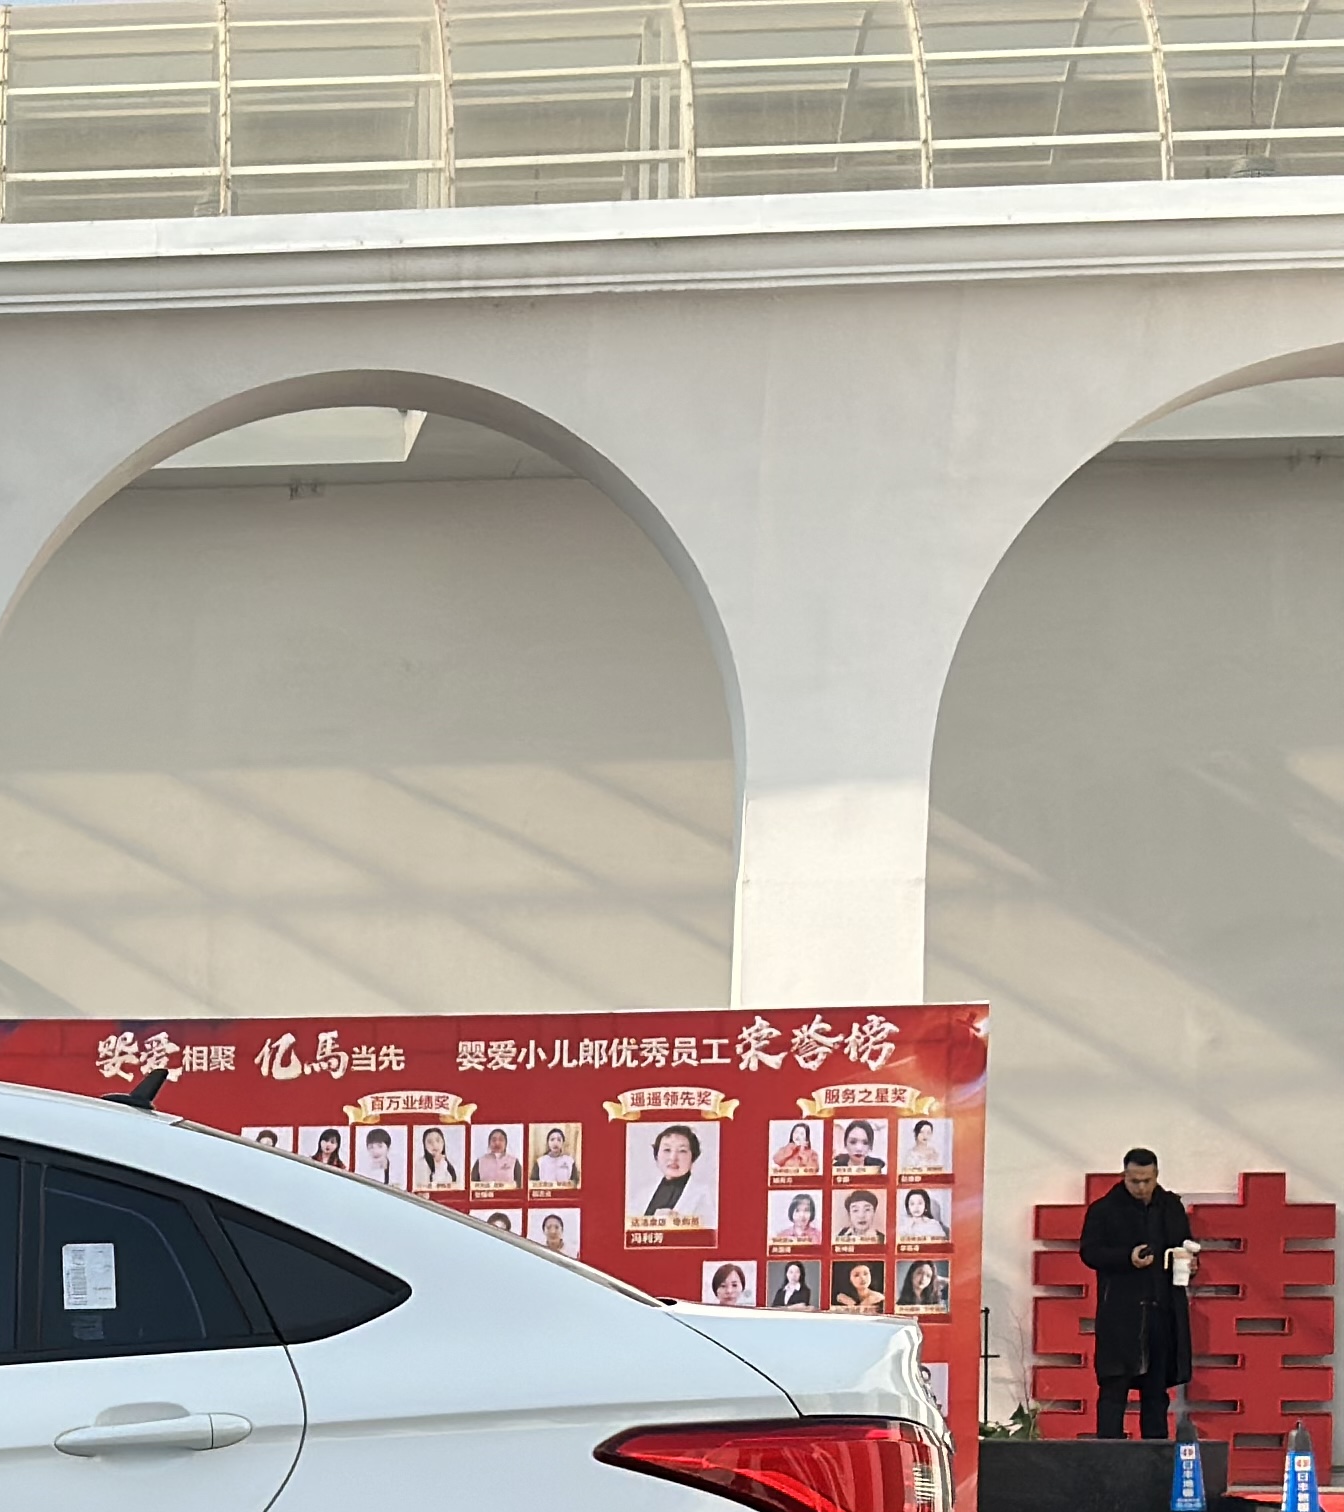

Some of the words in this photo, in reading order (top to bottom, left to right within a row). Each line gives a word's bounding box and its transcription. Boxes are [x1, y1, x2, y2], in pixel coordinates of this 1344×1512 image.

[370, 1095, 450, 1111] 百万业绩奖
[630, 1091, 712, 1107] 遥遥领先奖
[824, 1088, 907, 1104] 服务之星奖
